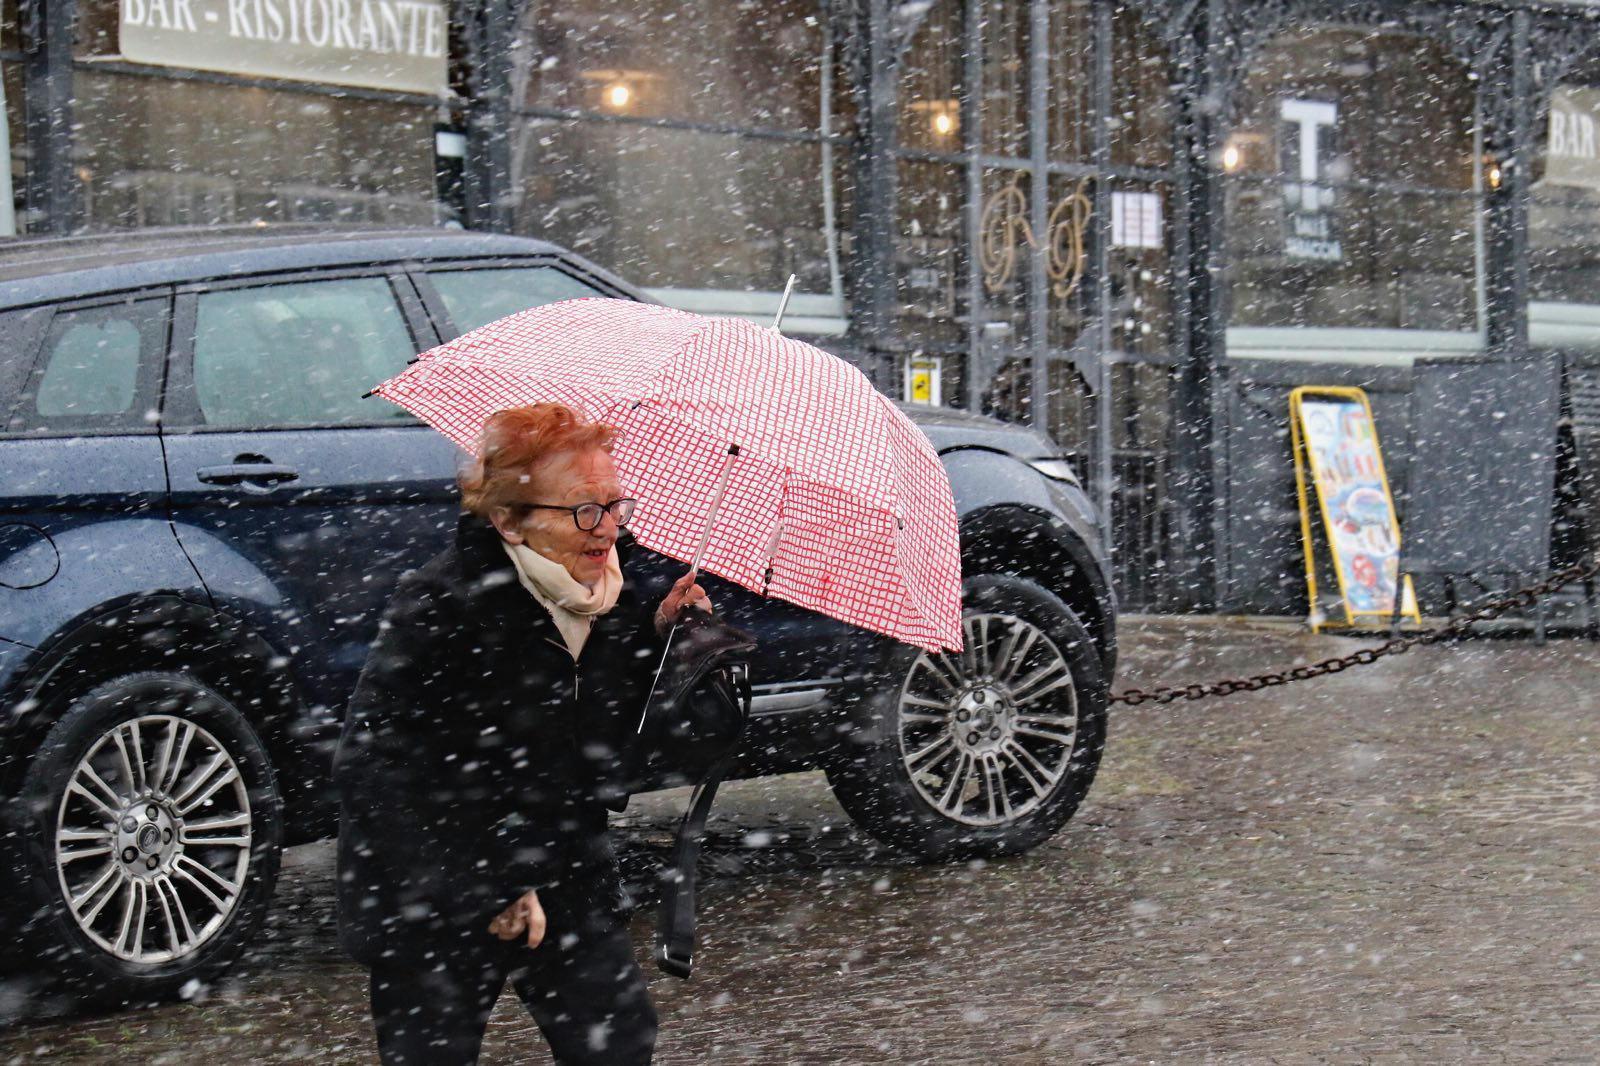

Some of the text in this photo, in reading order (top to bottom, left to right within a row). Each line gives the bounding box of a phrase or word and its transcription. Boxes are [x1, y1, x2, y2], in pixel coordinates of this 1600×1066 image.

[124, 0, 198, 32] BAR
[228, 0, 445, 57] RISTORANTE
[1550, 110, 1596, 158] BAR
